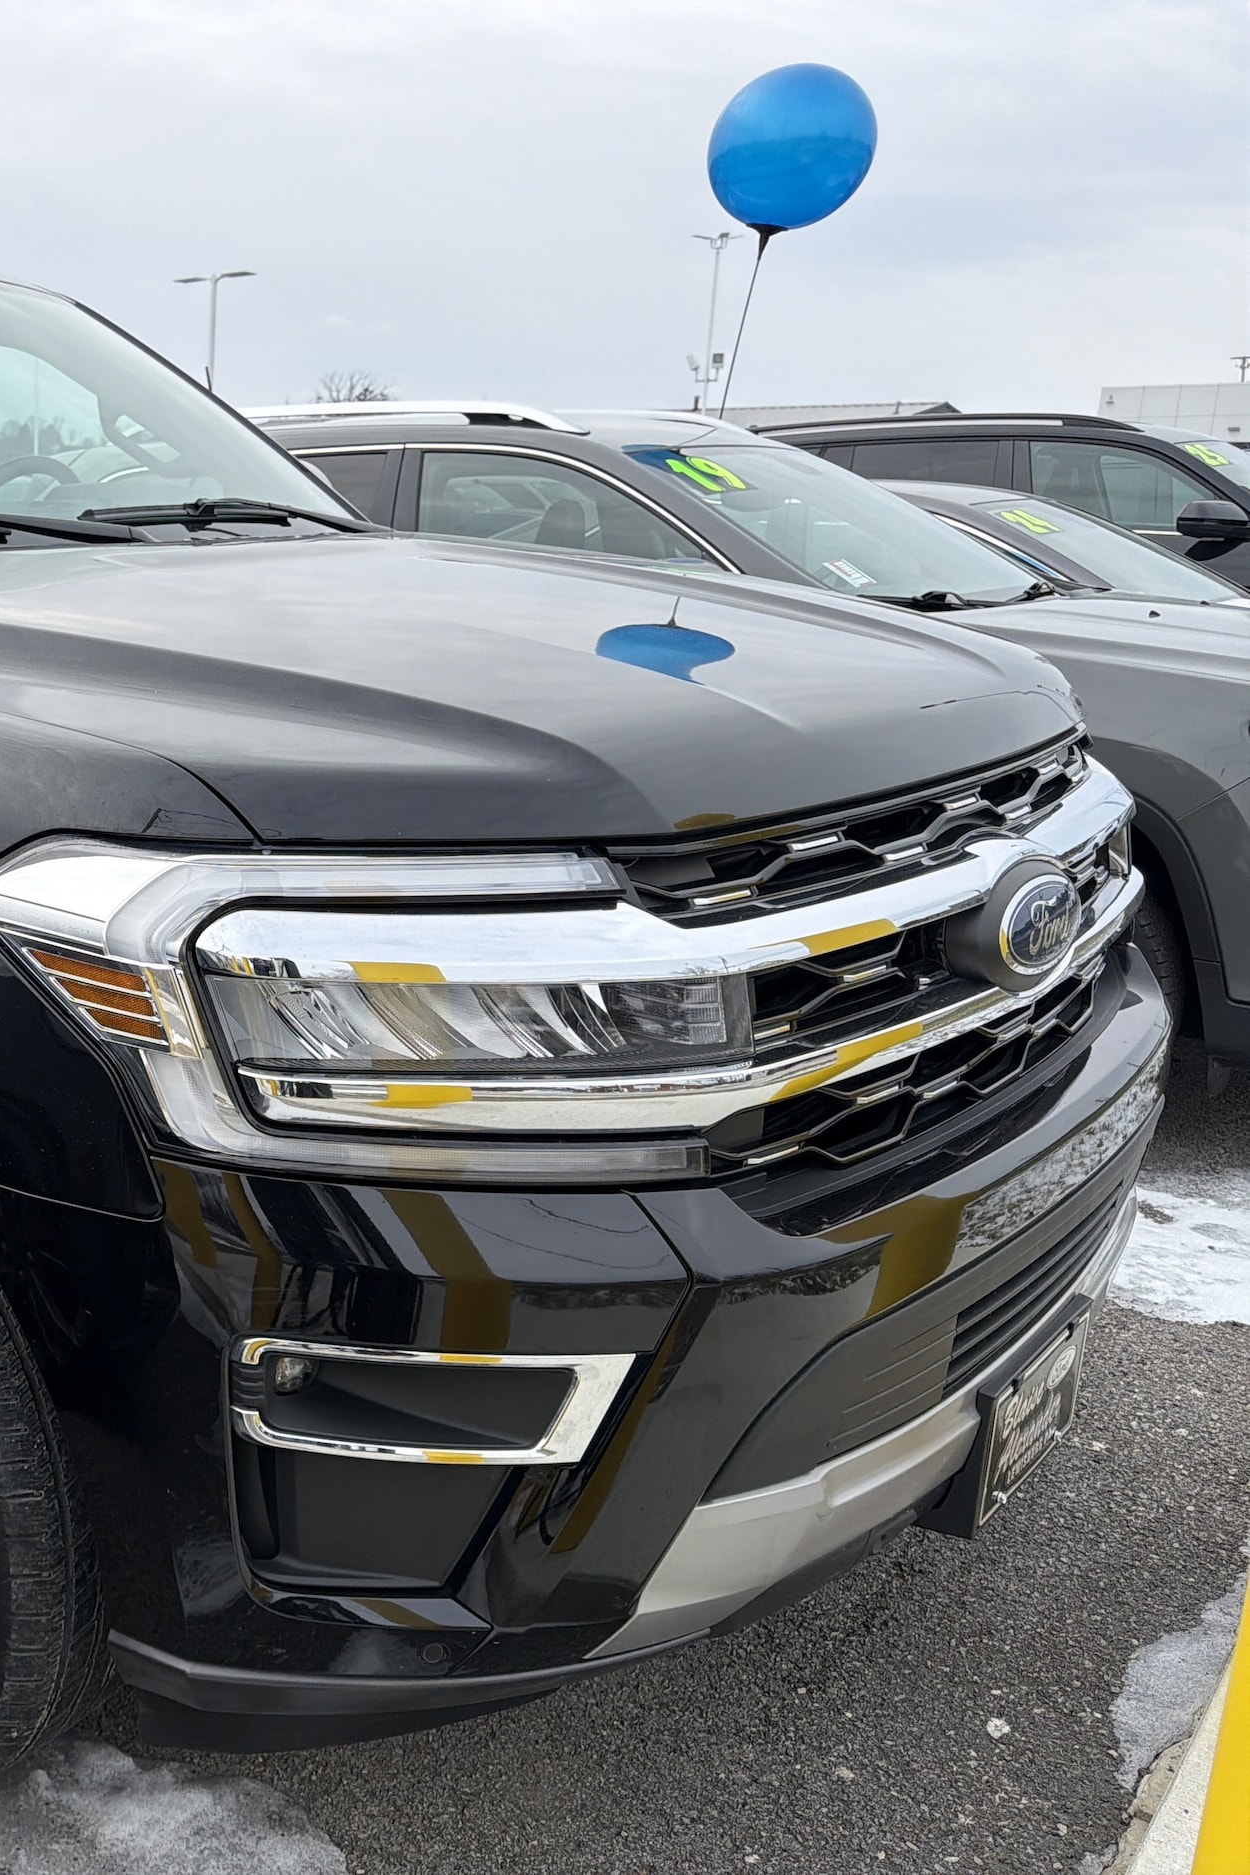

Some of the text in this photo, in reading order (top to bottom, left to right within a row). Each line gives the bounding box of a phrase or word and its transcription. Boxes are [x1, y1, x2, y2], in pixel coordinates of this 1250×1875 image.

[664, 456, 748, 492] 19
[1183, 443, 1229, 467] 25
[1000, 508, 1063, 535] 24
[1029, 896, 1071, 956] Ford
[1002, 1381, 1045, 1440] Blaise
[993, 1392, 1062, 1485] Alexander
